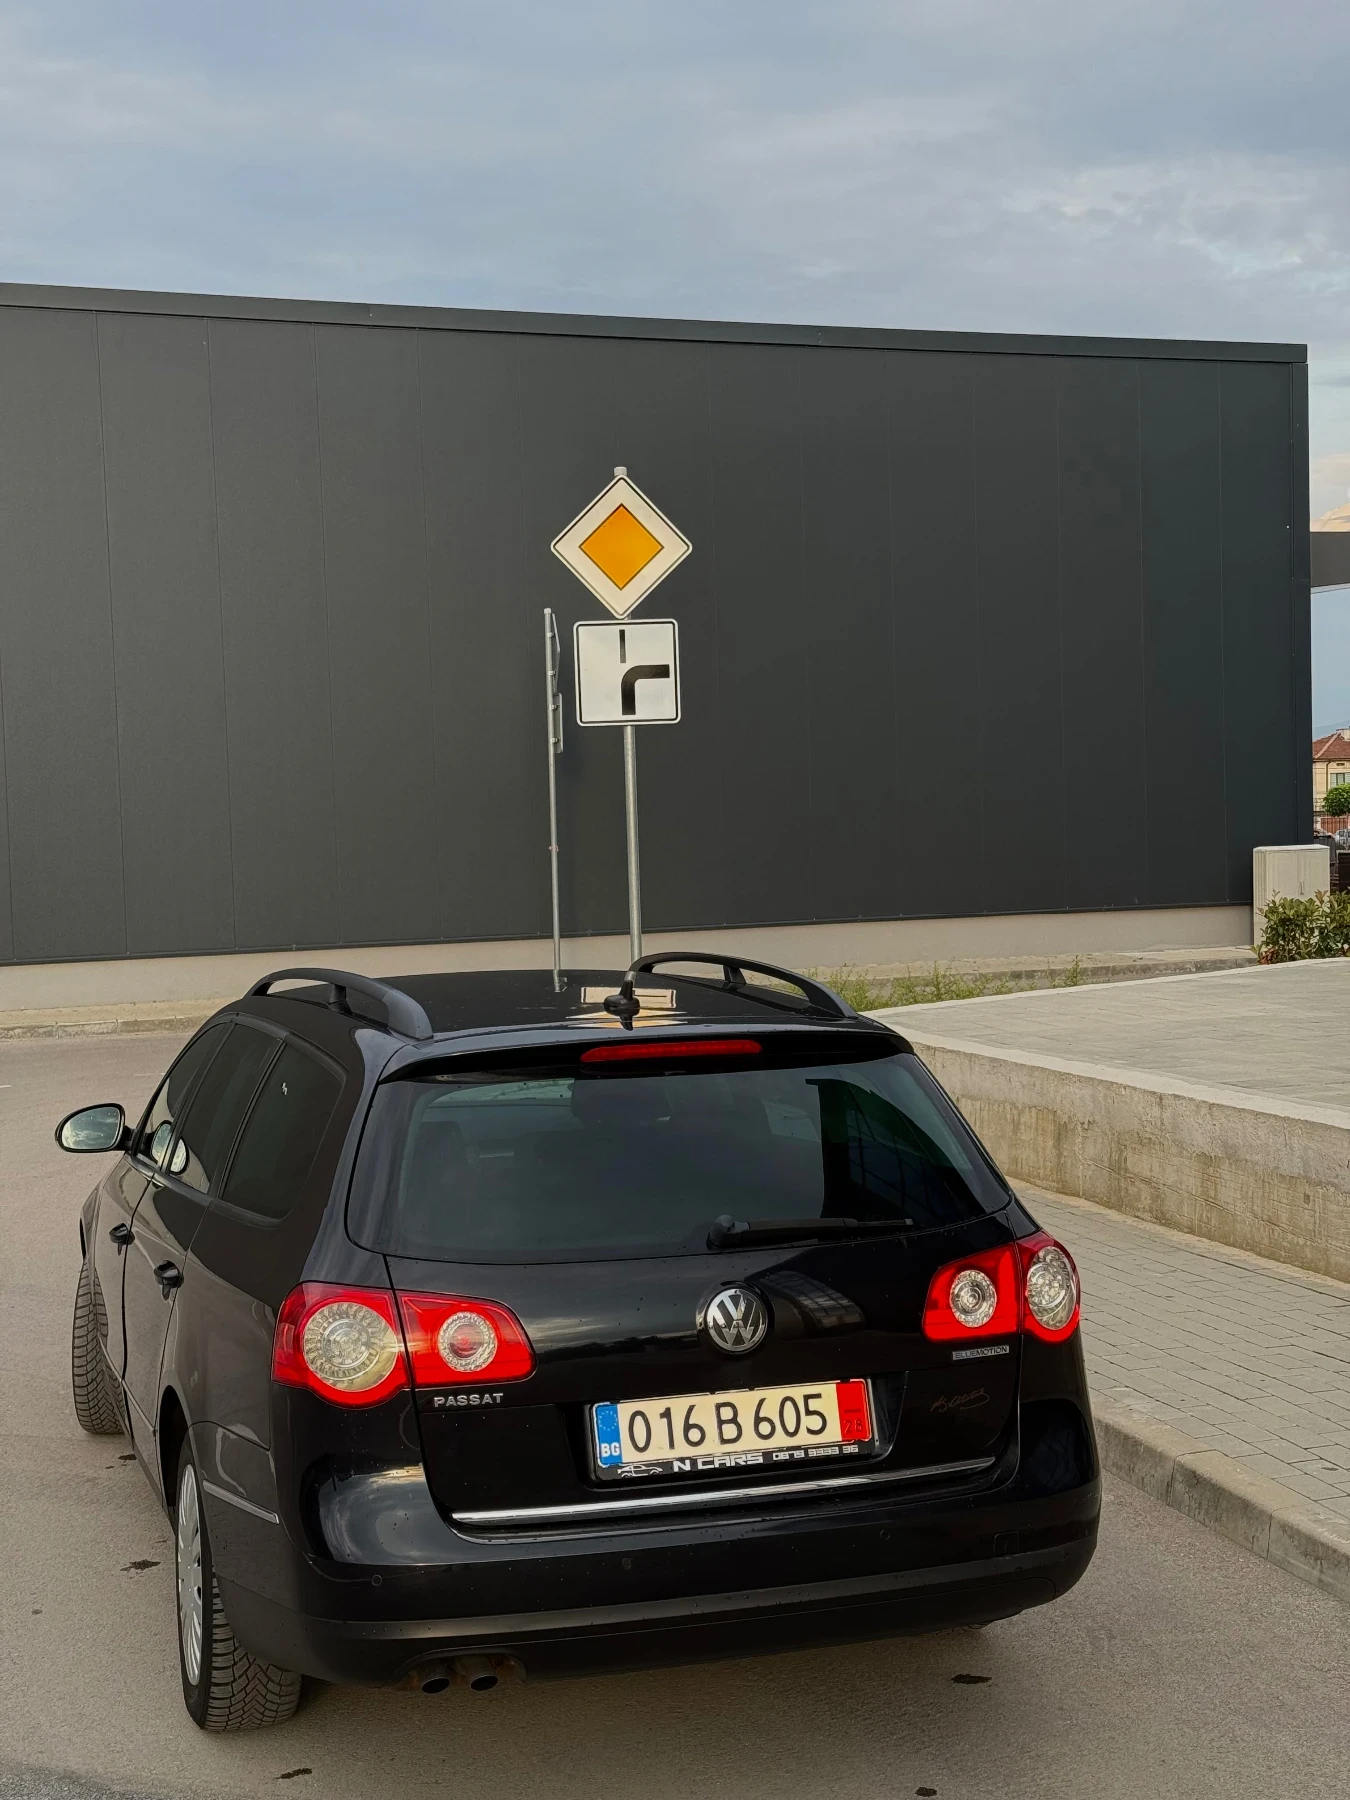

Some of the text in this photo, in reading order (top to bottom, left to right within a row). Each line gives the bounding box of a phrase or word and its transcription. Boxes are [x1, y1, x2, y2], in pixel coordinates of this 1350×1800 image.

[707, 1288, 766, 1351] VW
[434, 1393, 503, 1408] PASSAT
[628, 1393, 827, 1453] 016 B 605
[601, 1442, 620, 1457] BG
[673, 1459, 691, 1472] N
[697, 1452, 763, 1470] CARS
